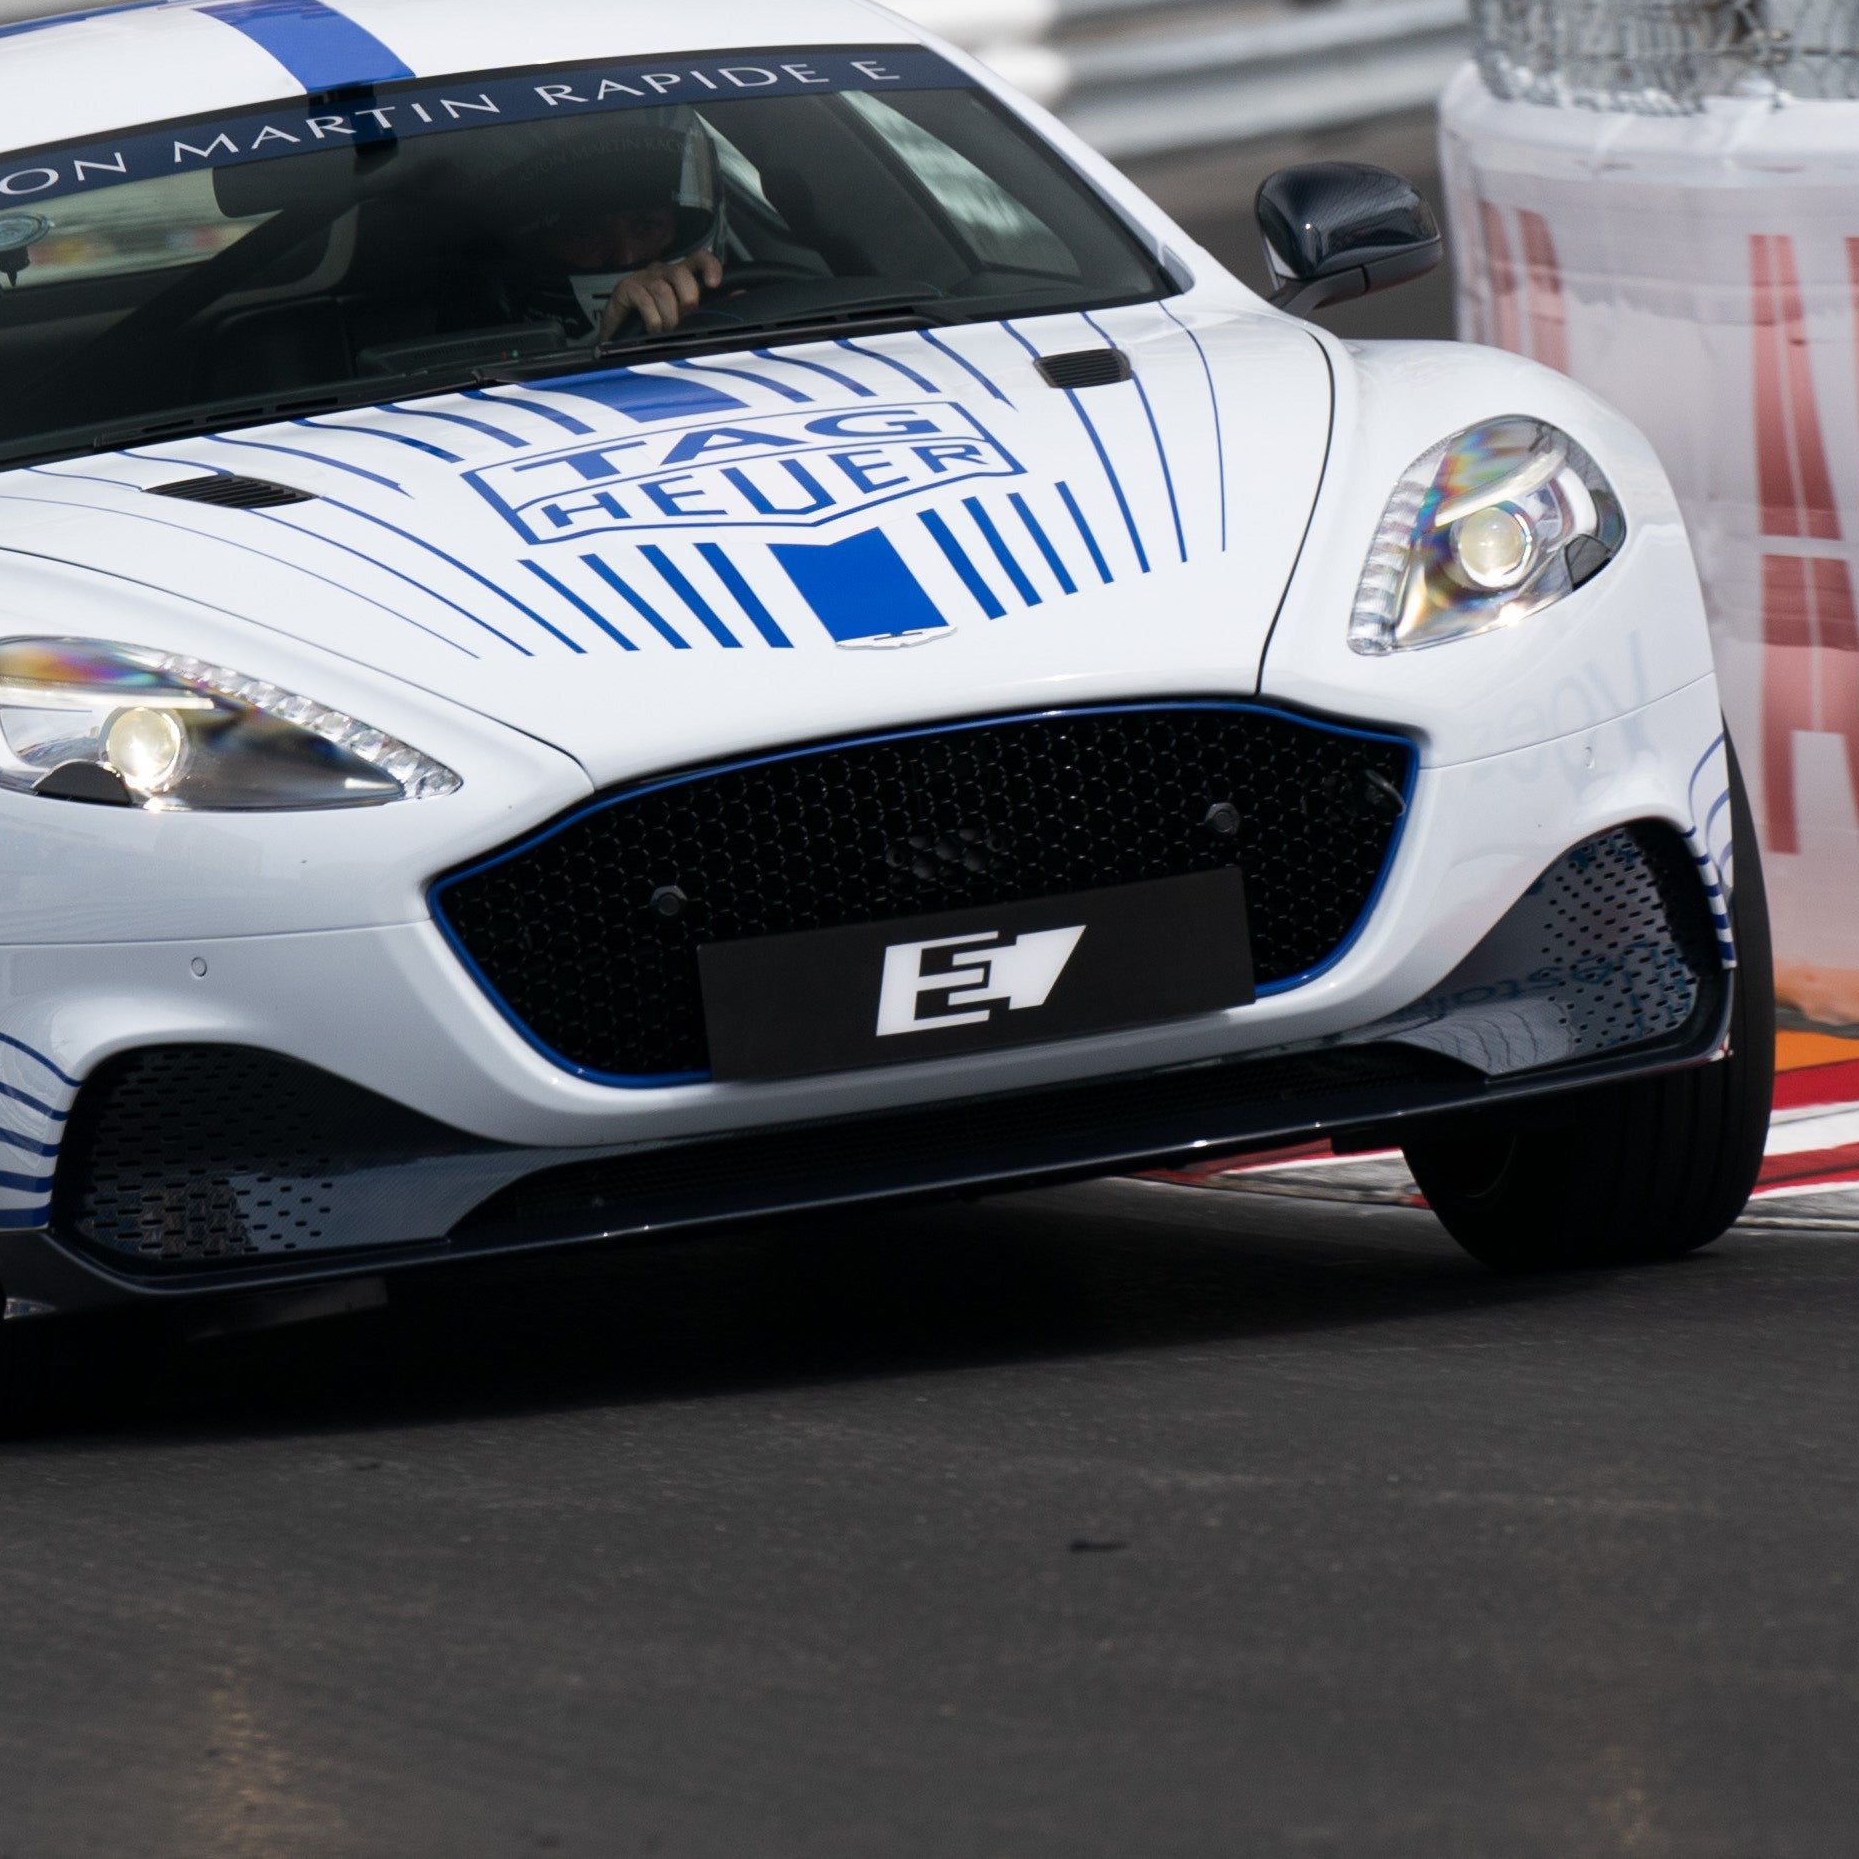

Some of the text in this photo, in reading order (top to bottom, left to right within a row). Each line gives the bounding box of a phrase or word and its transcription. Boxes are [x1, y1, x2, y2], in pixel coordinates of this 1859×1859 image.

[173, 93, 502, 165] MARTIN
[533, 62, 831, 107] RAPIDE
[848, 60, 902, 81] E
[512, 409, 941, 481] TAG
[541, 444, 990, 529] HEUER
